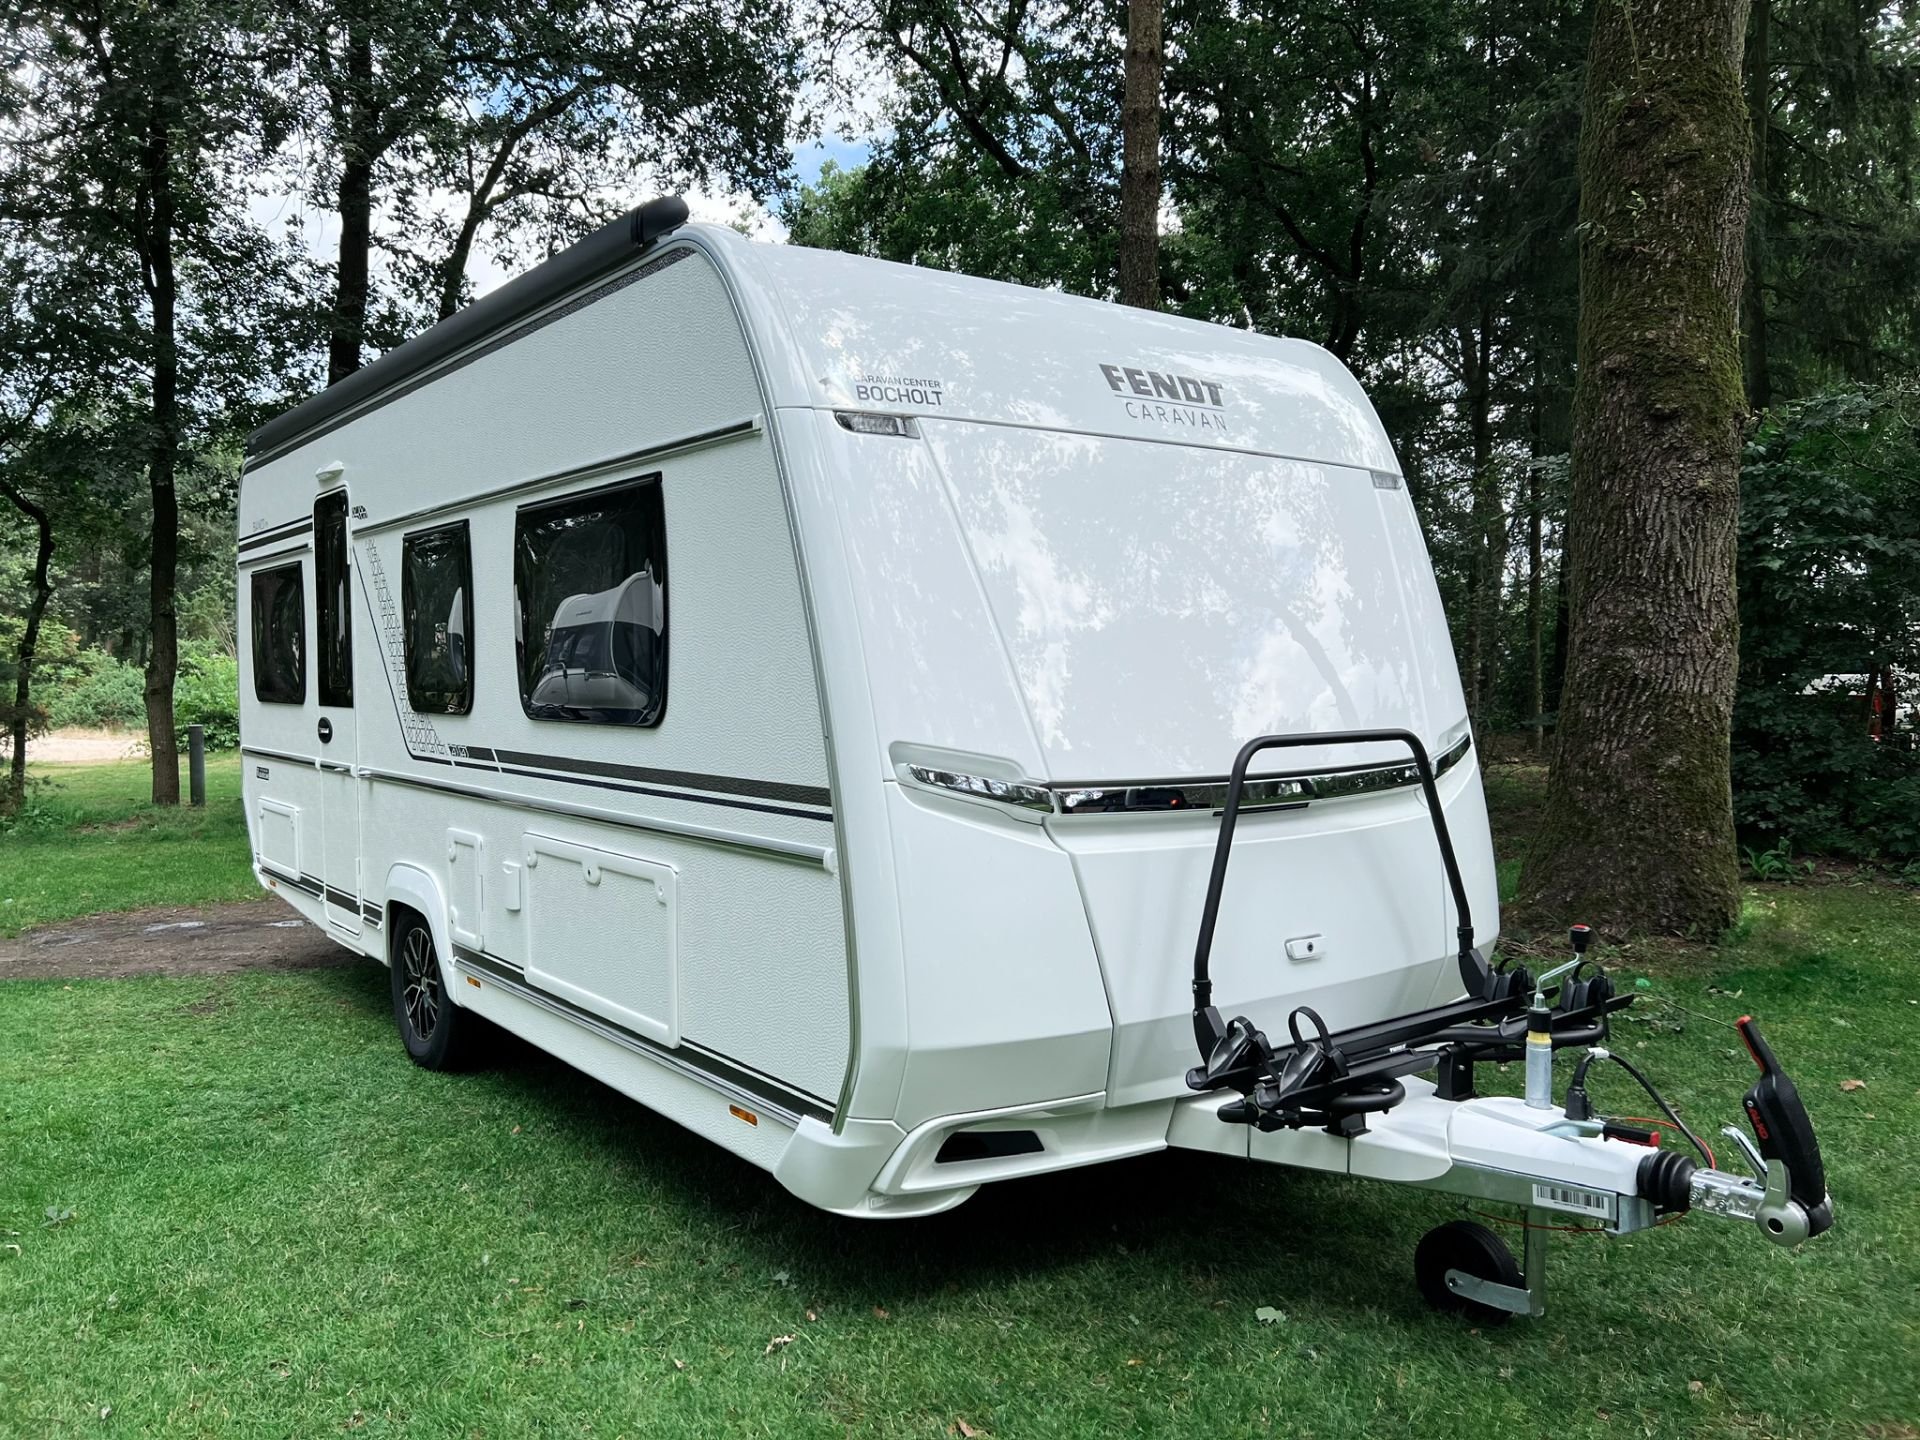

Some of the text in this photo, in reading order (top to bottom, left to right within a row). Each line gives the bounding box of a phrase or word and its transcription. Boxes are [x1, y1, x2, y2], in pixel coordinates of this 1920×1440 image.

[853, 374, 941, 389] CARAVAN CENTER
[1098, 363, 1224, 407] FENDT
[856, 384, 942, 405] BOCHOLT
[1125, 401, 1228, 431] CARAVAN
